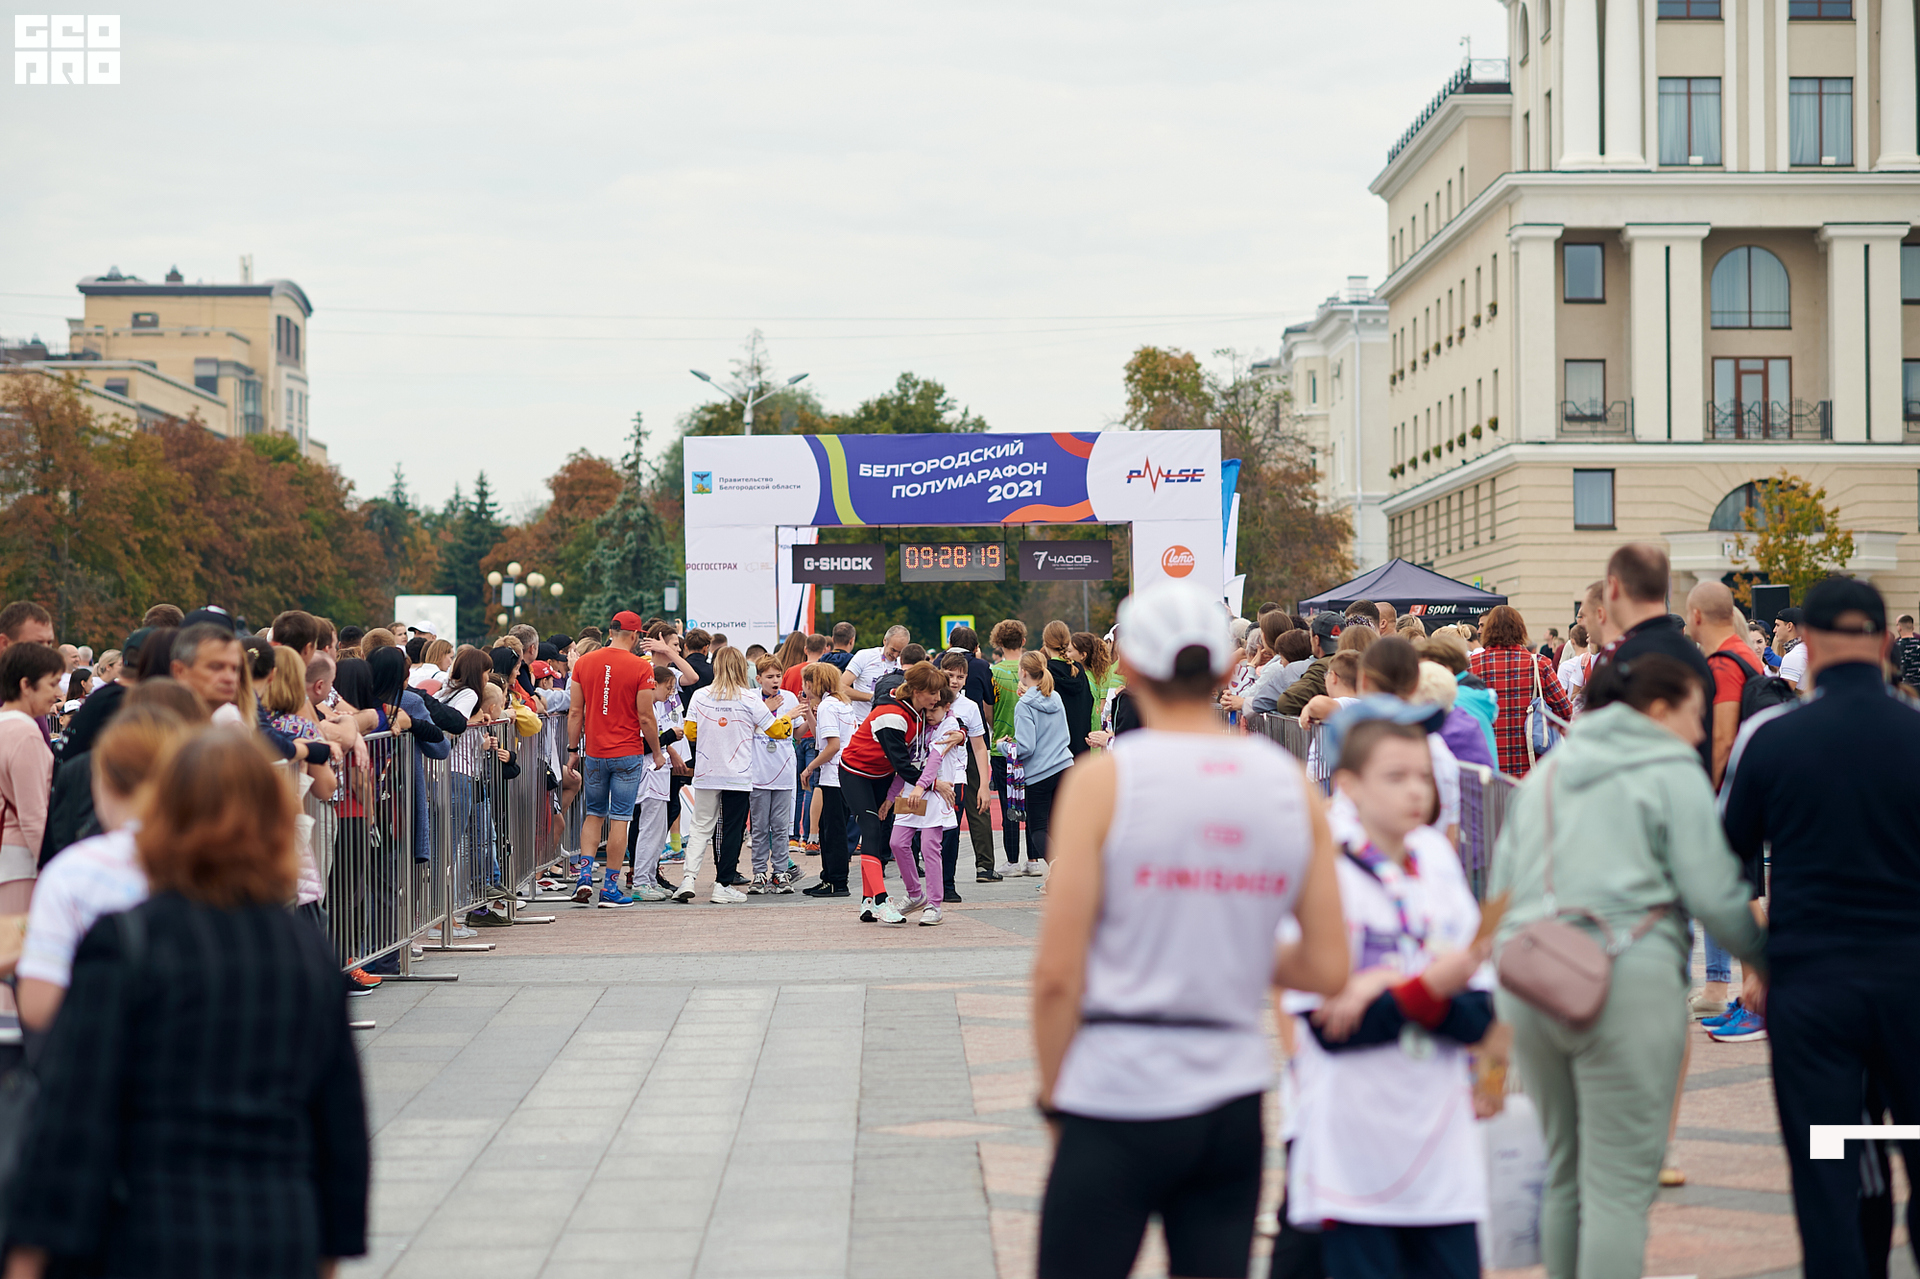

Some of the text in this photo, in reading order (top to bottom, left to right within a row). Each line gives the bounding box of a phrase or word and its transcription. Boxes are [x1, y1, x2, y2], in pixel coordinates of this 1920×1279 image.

[858, 439, 1024, 478] БЕЛГОРОДСКИЙ
[718, 476, 774, 484] Правительство
[891, 461, 1048, 499] ПОЛУМАРАФОН
[771, 483, 801, 491] области
[987, 480, 1042, 504] 2021
[905, 545, 1001, 569] 09:28:19
[1047, 555, 1093, 564] ЧАСОВ
[685, 562, 738, 571] РОСГОССТРАХ
[803, 557, 873, 571] G-SHOCK
[1427, 603, 1458, 616] sport
[700, 621, 747, 630] открытие
[602, 664, 613, 716] pulse-team.ru
